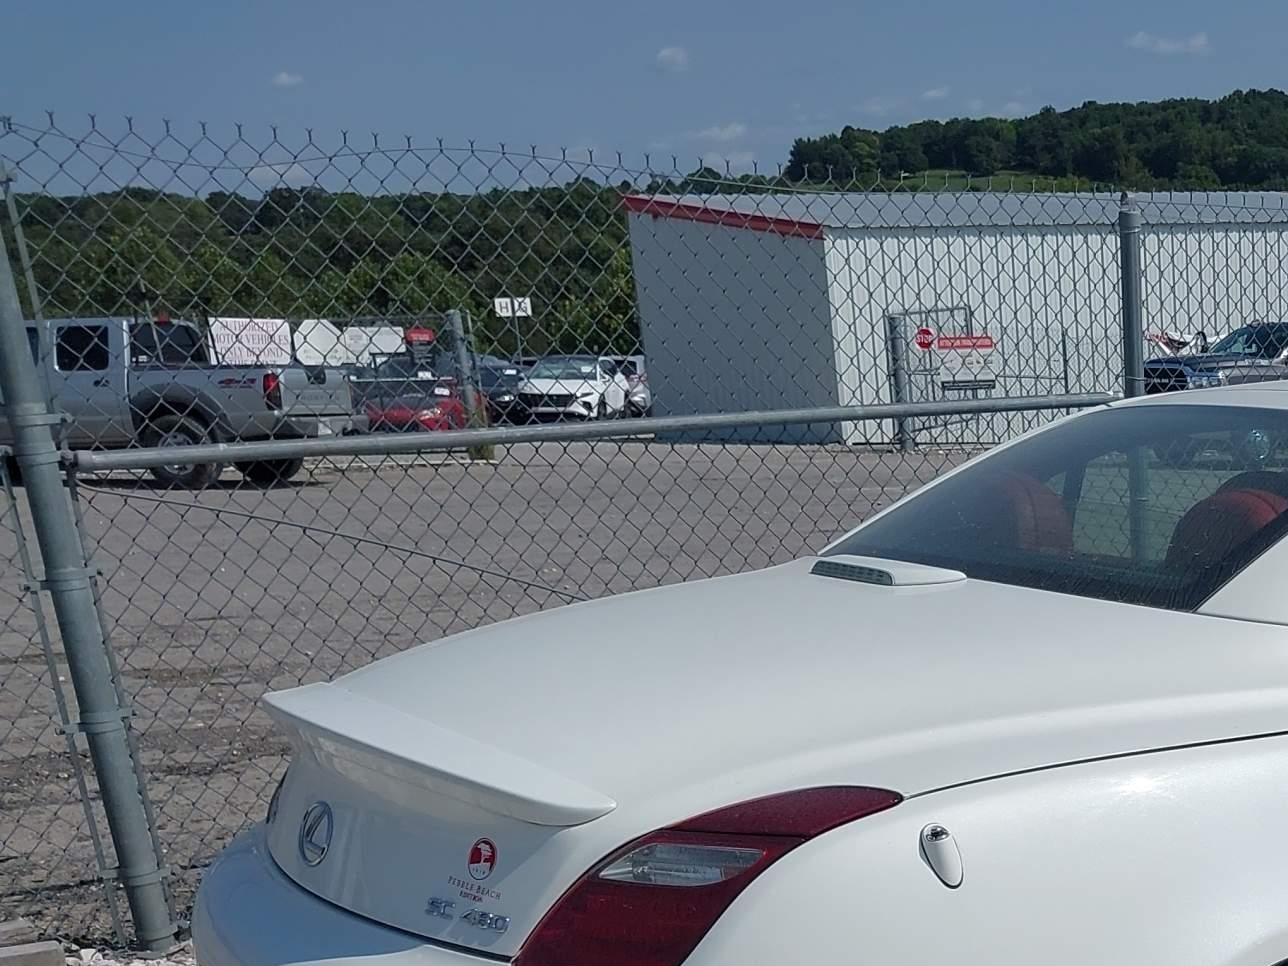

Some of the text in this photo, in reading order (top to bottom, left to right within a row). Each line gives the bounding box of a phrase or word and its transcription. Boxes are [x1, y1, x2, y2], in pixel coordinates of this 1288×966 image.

[499, 301, 510, 313] H
[915, 334, 933, 343] STOP
[425, 897, 456, 920] SC
